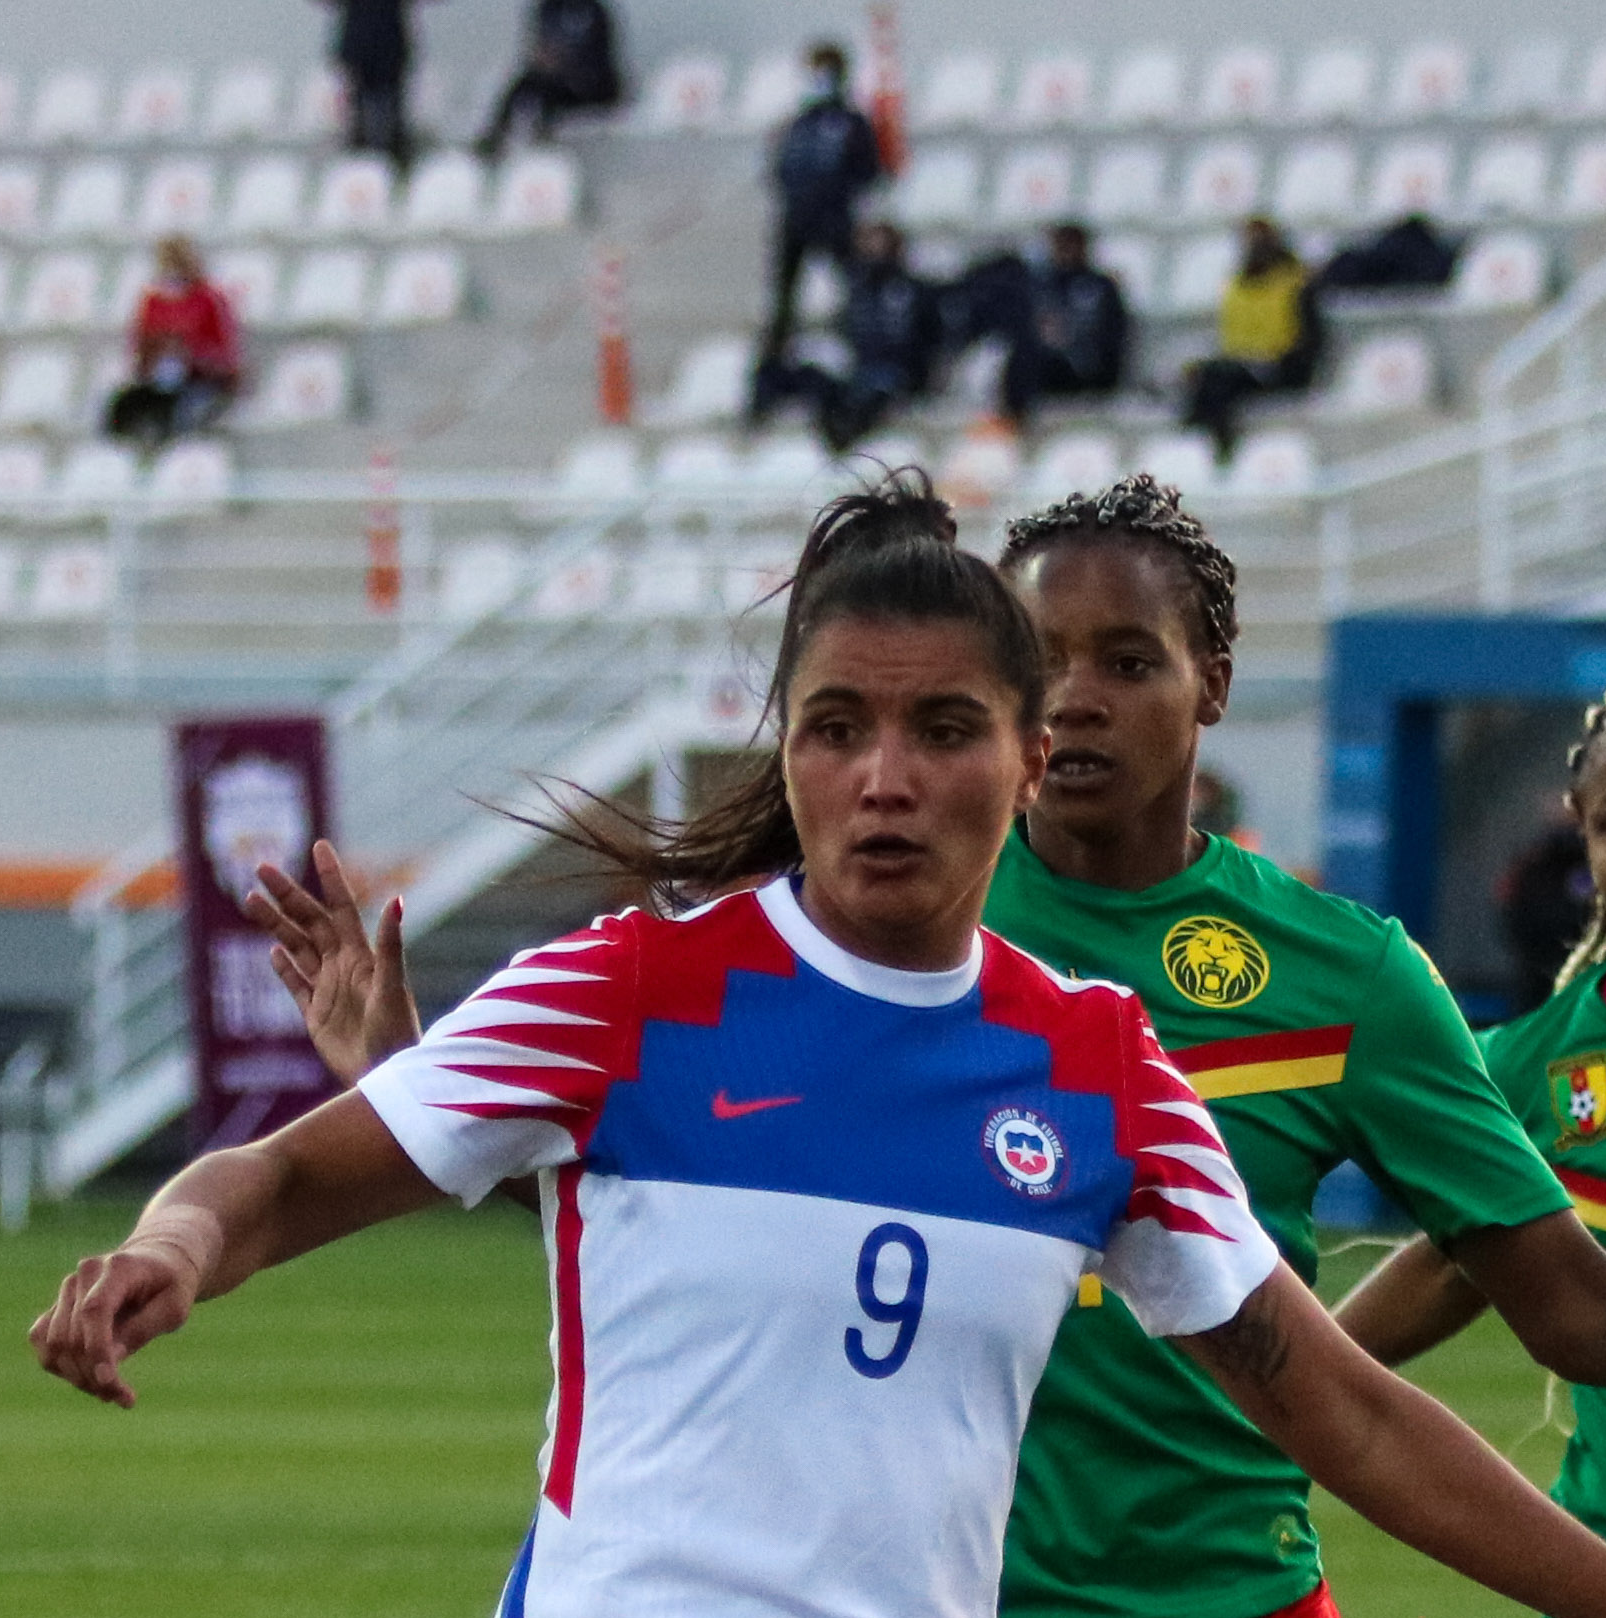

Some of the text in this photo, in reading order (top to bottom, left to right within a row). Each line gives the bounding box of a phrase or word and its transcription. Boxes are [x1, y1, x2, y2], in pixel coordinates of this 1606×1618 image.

[1025, 1110, 1038, 1125] DE
[1009, 1178, 1023, 1192] DE
[844, 1221, 929, 1380] 9
